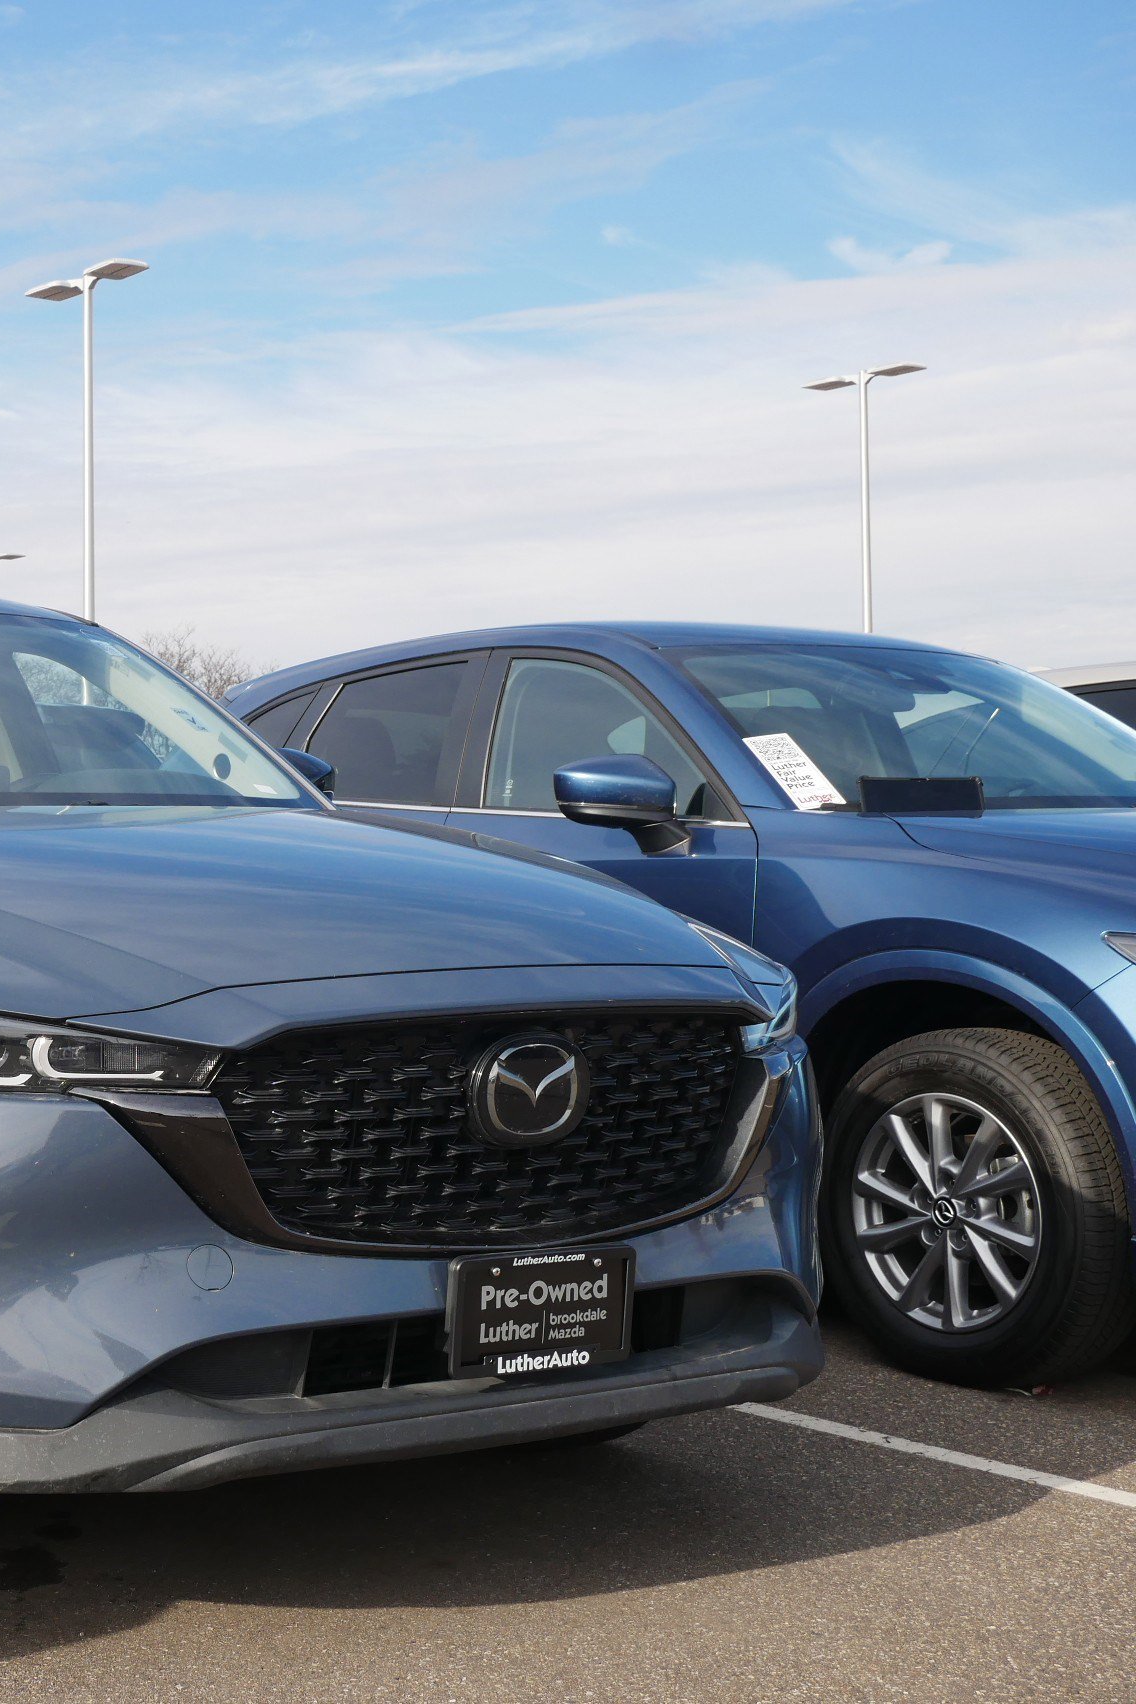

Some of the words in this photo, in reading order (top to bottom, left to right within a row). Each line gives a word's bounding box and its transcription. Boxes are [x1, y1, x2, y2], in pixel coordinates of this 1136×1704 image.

[771, 761, 807, 771] Luther
[777, 769, 796, 777] Fair
[781, 775, 813, 783] Value
[787, 781, 815, 789] Price
[512, 1253, 585, 1267] LutherAuto.com
[481, 1273, 608, 1311] Pre-Owned
[549, 1308, 607, 1325] brookdale
[479, 1320, 539, 1344] Luther
[548, 1325, 584, 1340] Mazda
[497, 1350, 590, 1374] LutherAuto
